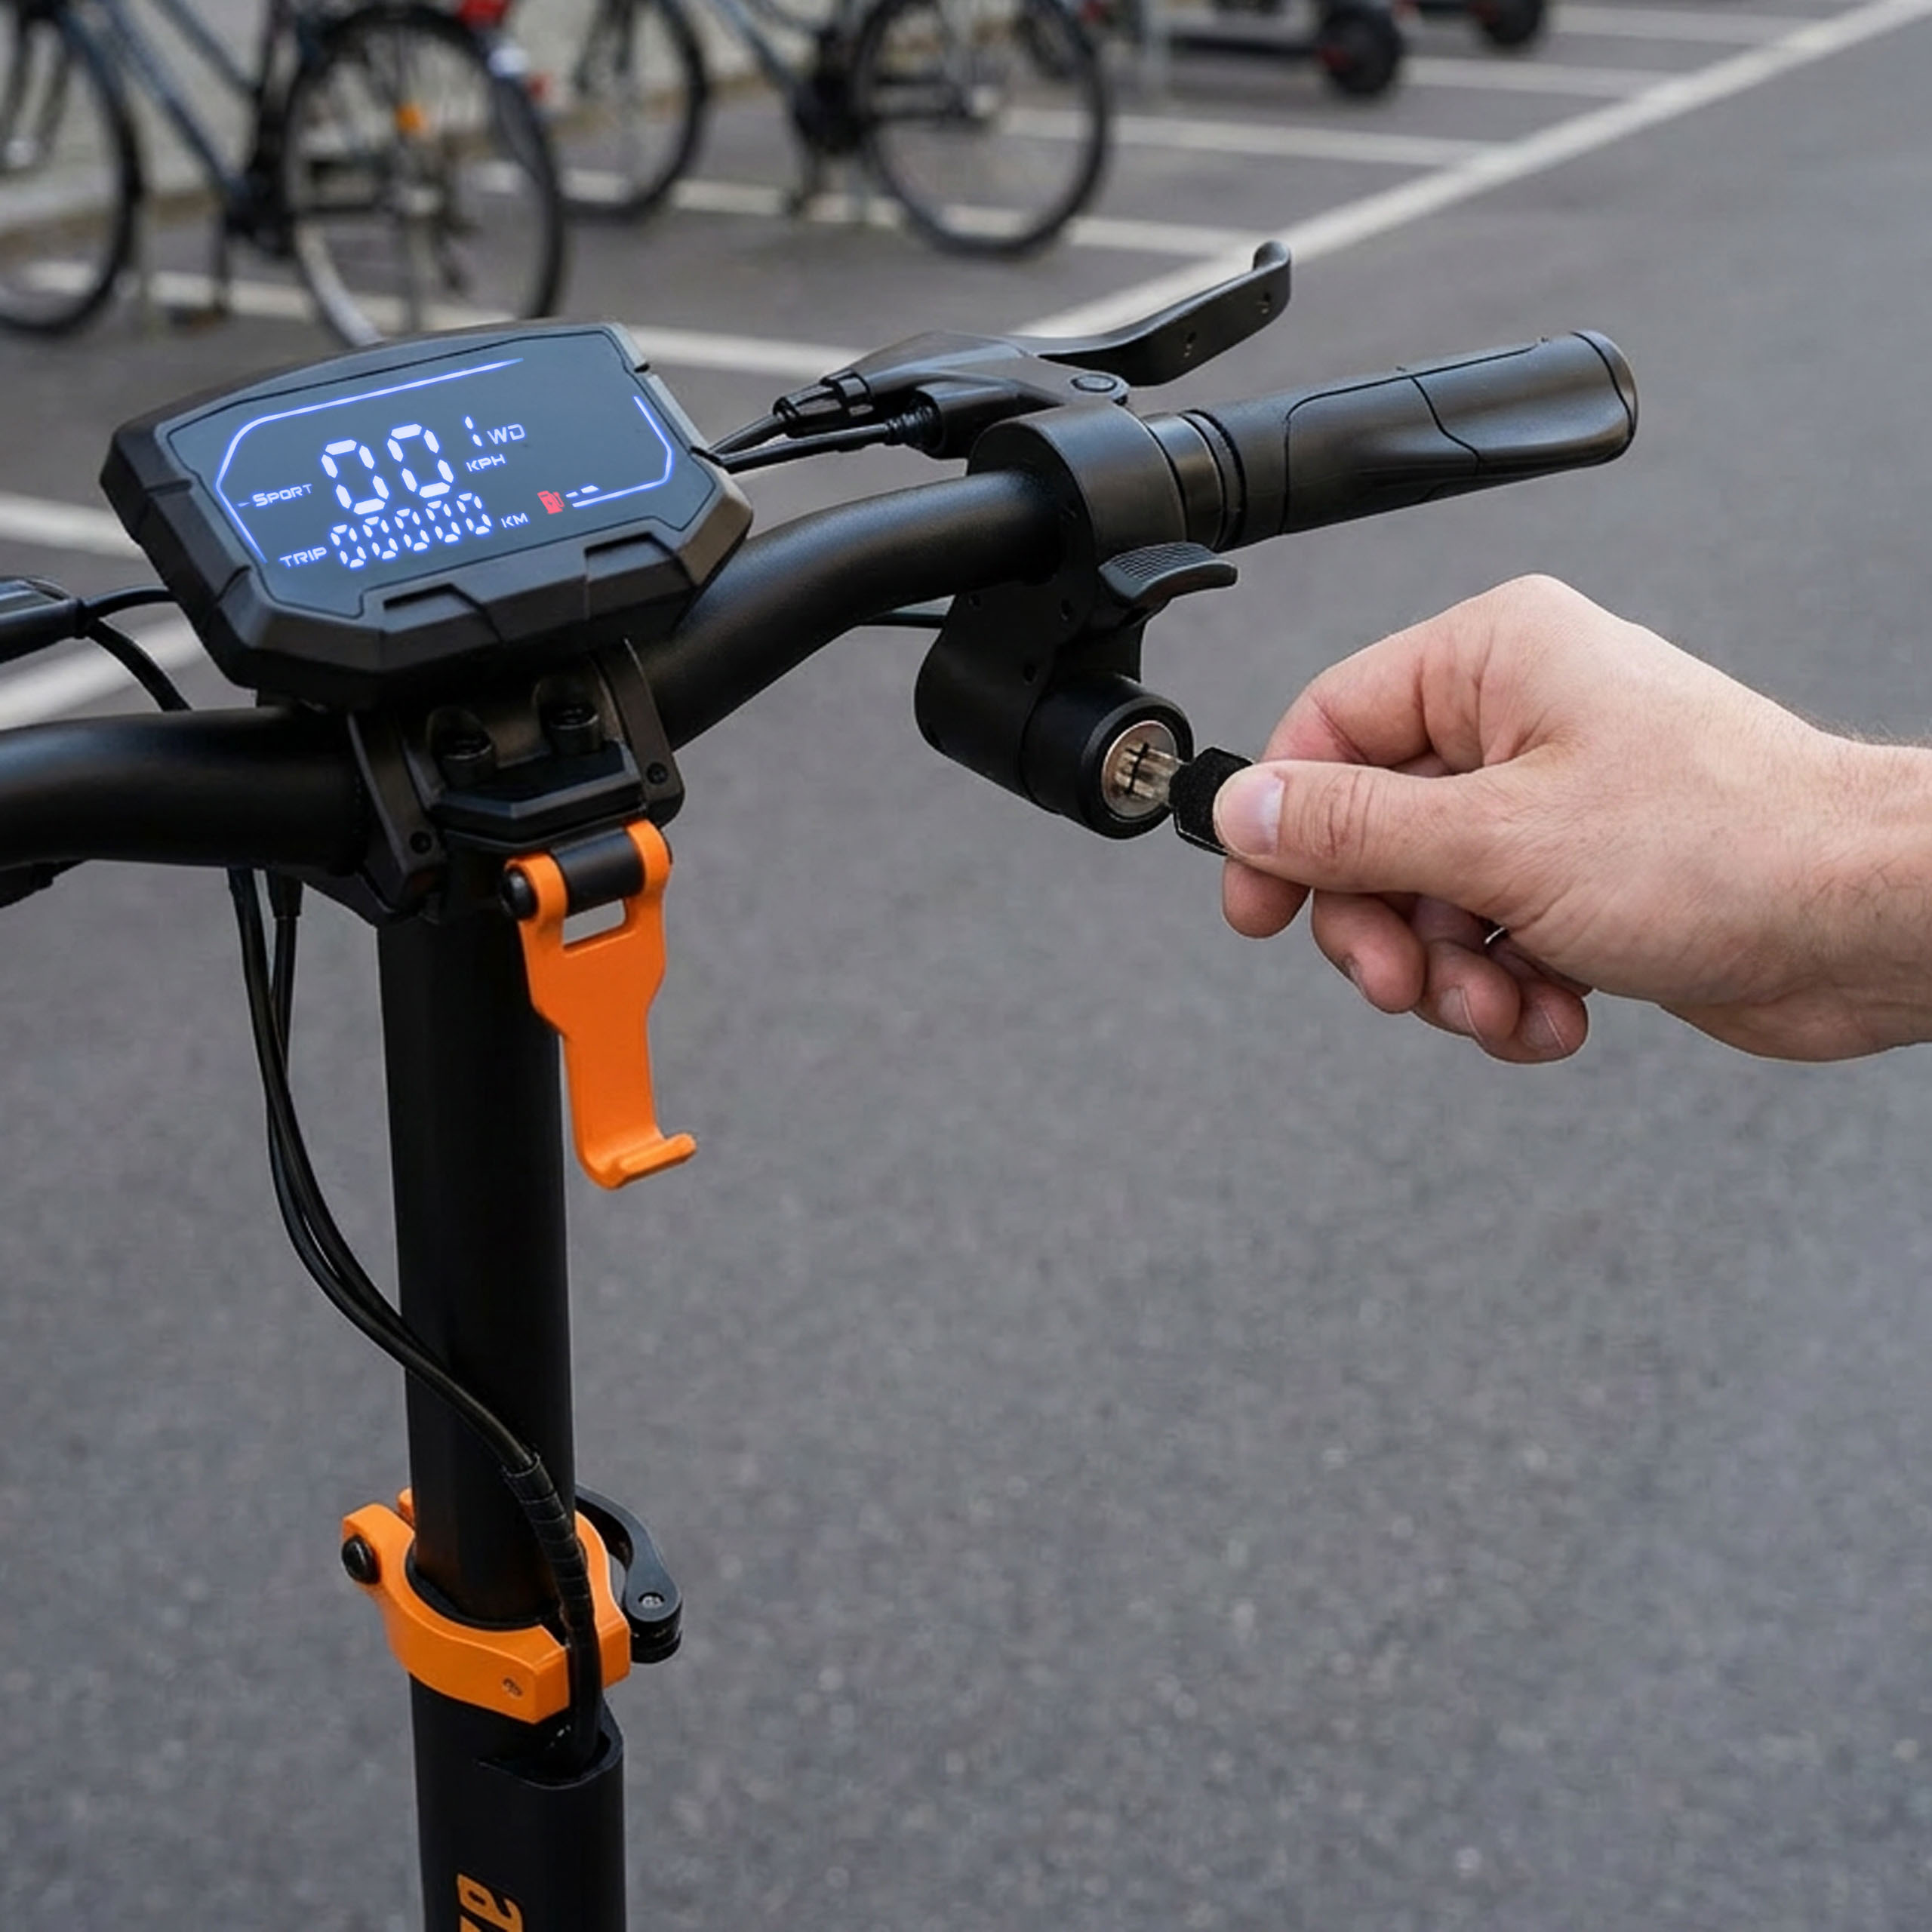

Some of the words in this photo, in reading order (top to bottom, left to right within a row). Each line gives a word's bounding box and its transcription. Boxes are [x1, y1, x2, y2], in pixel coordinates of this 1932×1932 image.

[252, 484, 312, 506] SPORT
[321, 423, 454, 515] 00
[466, 454, 506, 472] KPH
[279, 547, 327, 567] TRIP
[331, 493, 492, 568] 00000
[500, 512, 528, 528] KM
